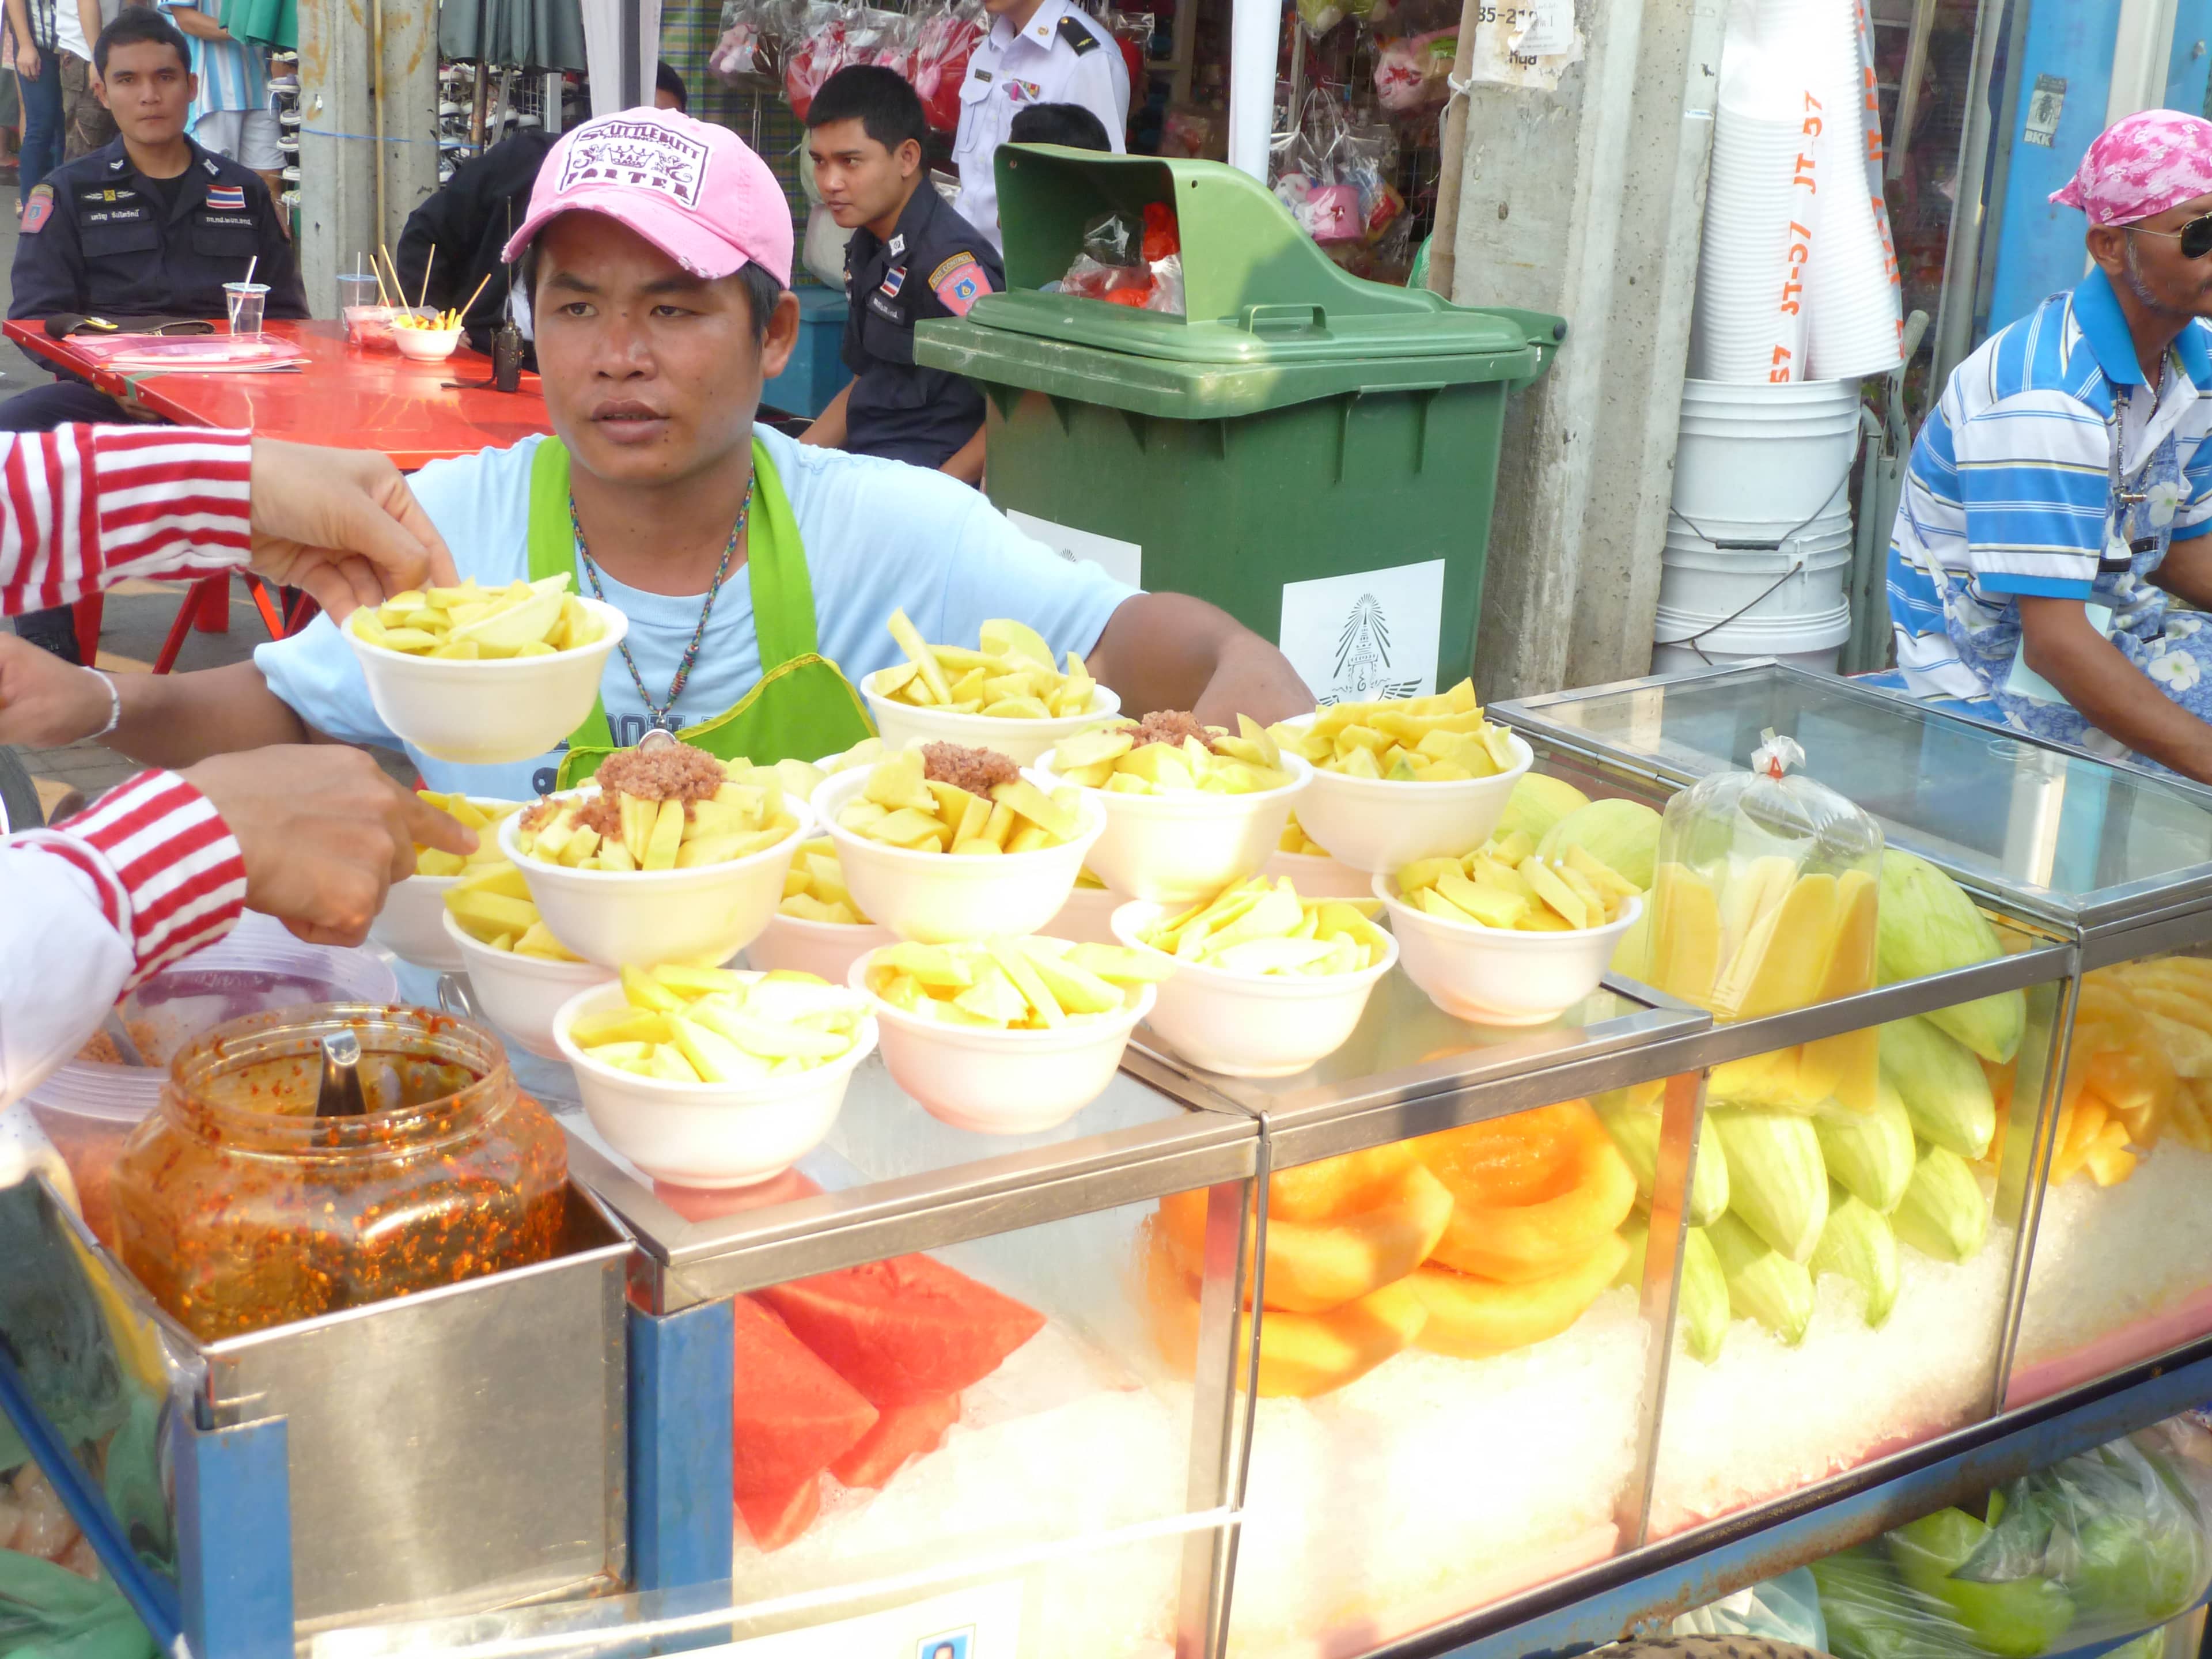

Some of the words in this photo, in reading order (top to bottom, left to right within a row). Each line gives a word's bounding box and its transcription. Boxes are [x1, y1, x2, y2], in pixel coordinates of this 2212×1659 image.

[1478, 7, 1539, 25] 85-2
[578, 124, 700, 160] SCUTTLEBUTT
[1793, 89, 1823, 195] JT-57
[1781, 220, 1812, 316] JT-57
